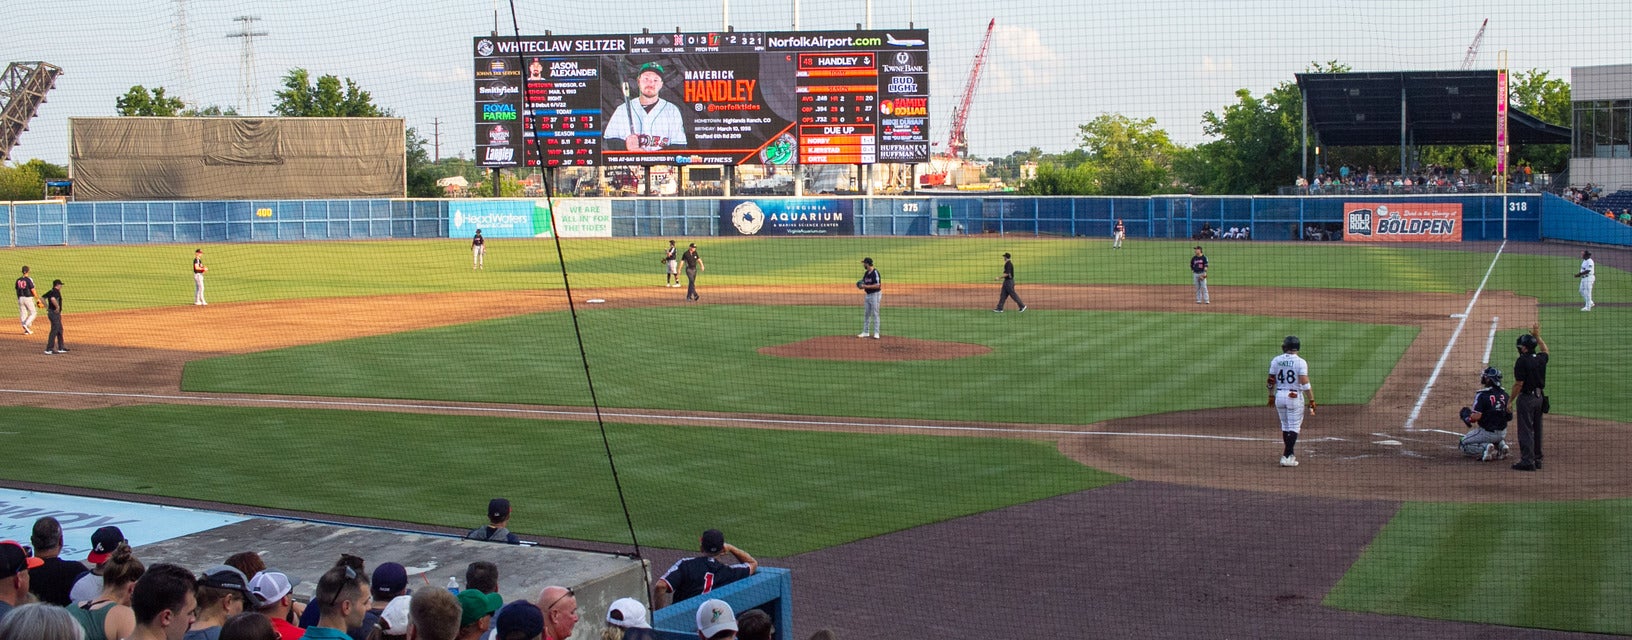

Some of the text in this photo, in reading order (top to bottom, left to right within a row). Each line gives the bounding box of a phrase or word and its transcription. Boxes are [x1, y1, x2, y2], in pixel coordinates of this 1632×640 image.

[497, 38, 626, 53] WHITECLAW SELTZER
[769, 36, 882, 48] NorfolkAirport.com
[818, 58, 857, 66] HANDLEY
[550, 69, 598, 77] ALEXANDER
[685, 71, 734, 80] MAVERICK
[479, 86, 519, 96] Smithfield
[684, 80, 756, 102] HANDLEY
[889, 84, 918, 92] LIGHT
[483, 104, 516, 112] ROYAL
[483, 112, 517, 120] FARMS
[486, 147, 514, 162] Langley
[902, 203, 918, 212] 375
[1509, 202, 1527, 211] 318
[256, 208, 273, 216] 400
[770, 212, 844, 221] AQUARIUM
[463, 212, 528, 224] HeadWaters
[1350, 213, 1370, 222] BOLD
[1350, 222, 1370, 230] ROCK
[1376, 219, 1455, 234] BOLDPEN
[1278, 369, 1296, 384] 48
[702, 572, 714, 594] 1
